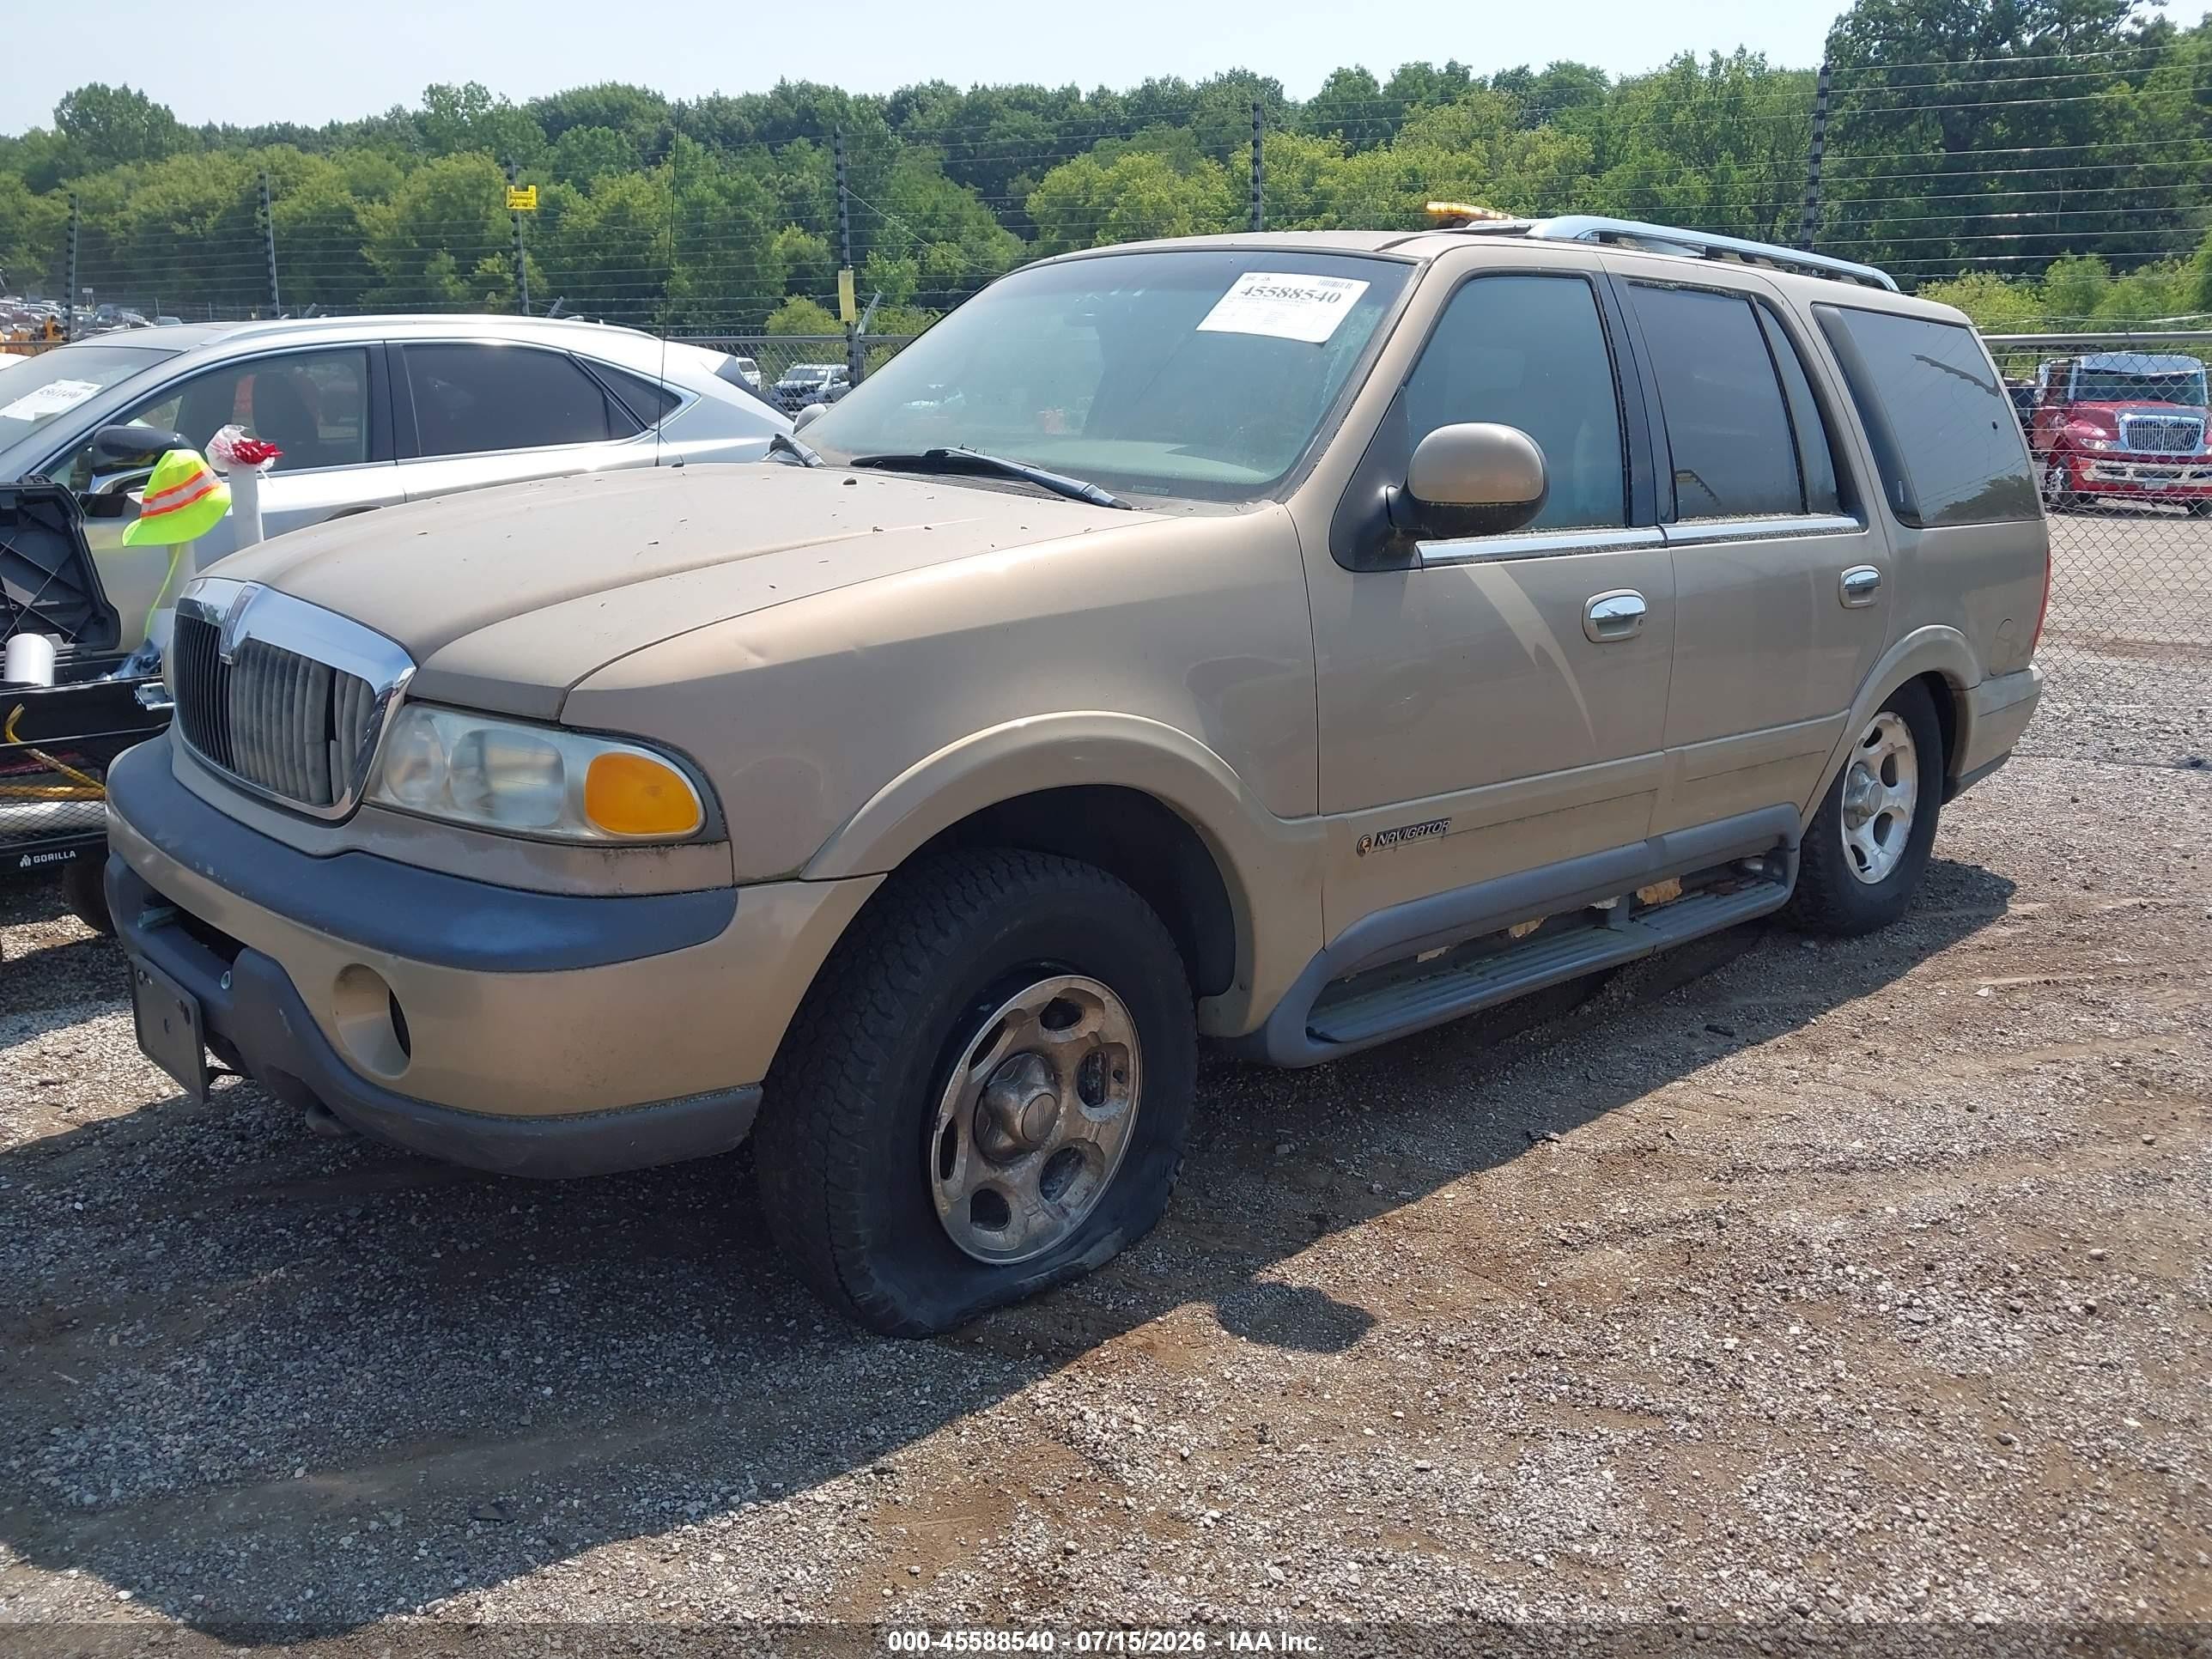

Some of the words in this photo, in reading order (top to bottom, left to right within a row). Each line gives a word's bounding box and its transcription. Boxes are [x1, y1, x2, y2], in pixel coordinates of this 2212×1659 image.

[1241, 286, 1341, 303] 45588540
[1376, 819, 1450, 846] NAVIGATOR
[33, 850, 76, 863] GORILLA
